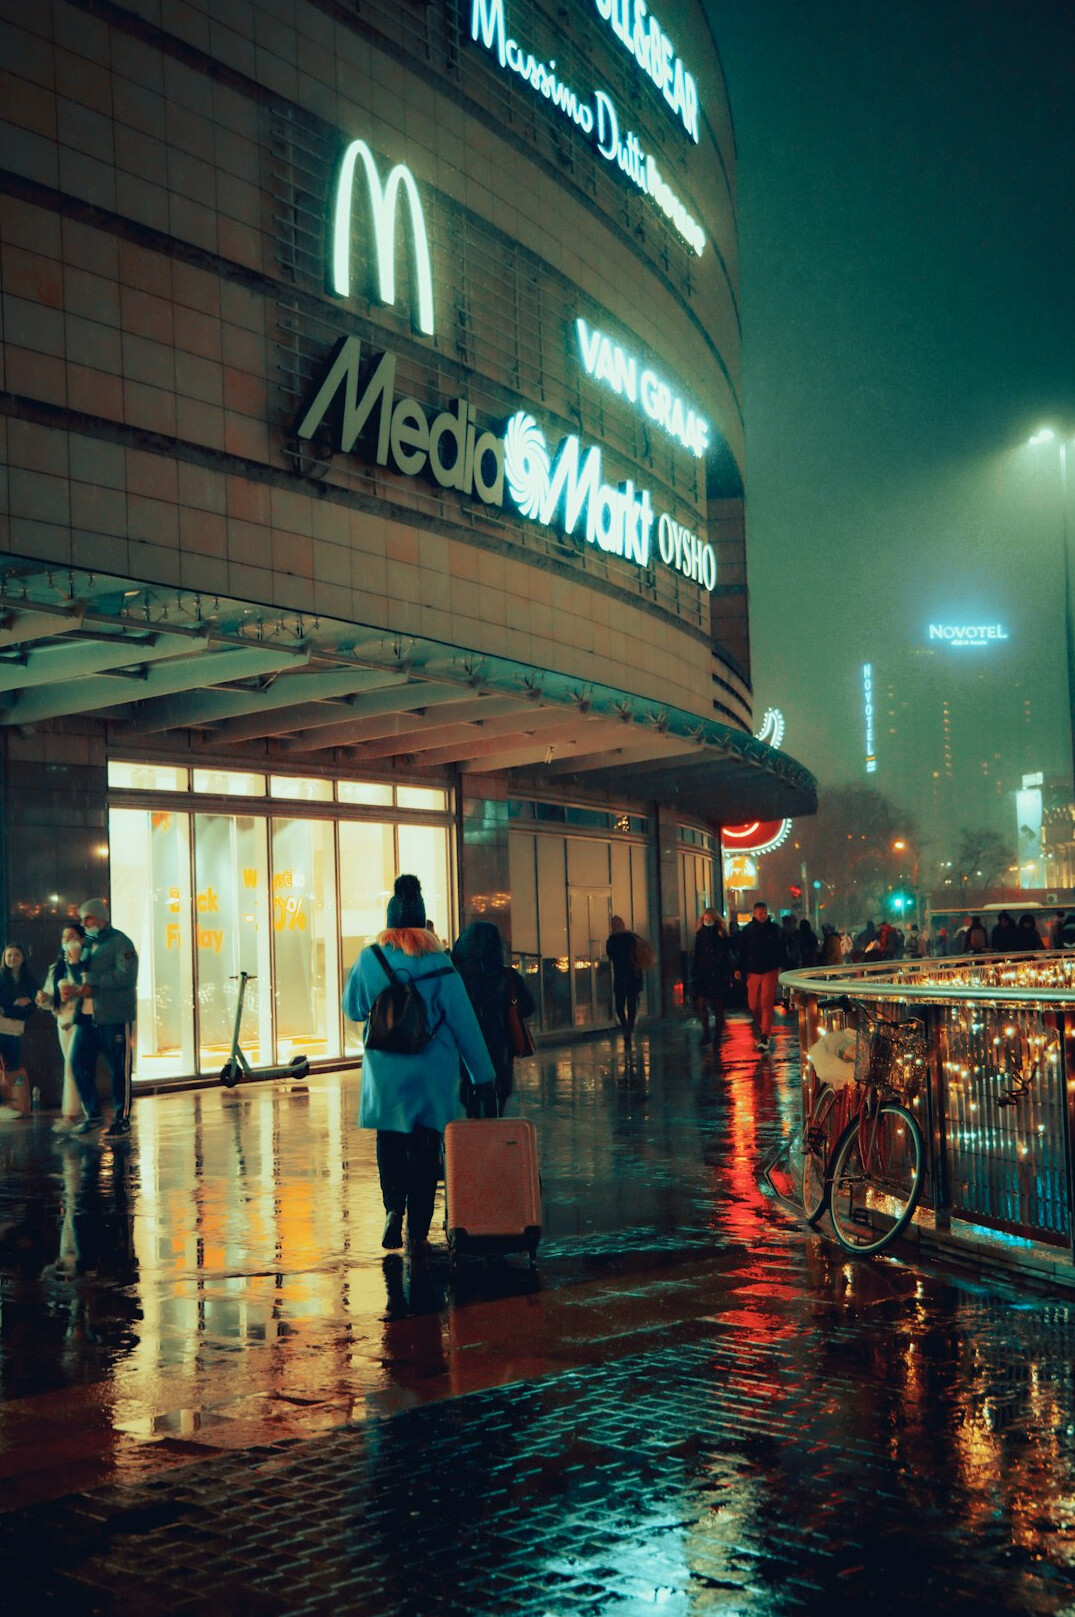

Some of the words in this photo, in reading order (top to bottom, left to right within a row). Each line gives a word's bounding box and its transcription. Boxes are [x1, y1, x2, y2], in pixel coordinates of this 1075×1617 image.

[471, 0, 594, 133] Massimo
[594, 90, 648, 194] Dutti
[576, 318, 636, 403] VAN
[640, 369, 709, 458] GRAAF
[658, 513, 716, 591] OYSHO
[929, 624, 1008, 639] NOVOTEL
[863, 663, 874, 756] NOVOTEL
